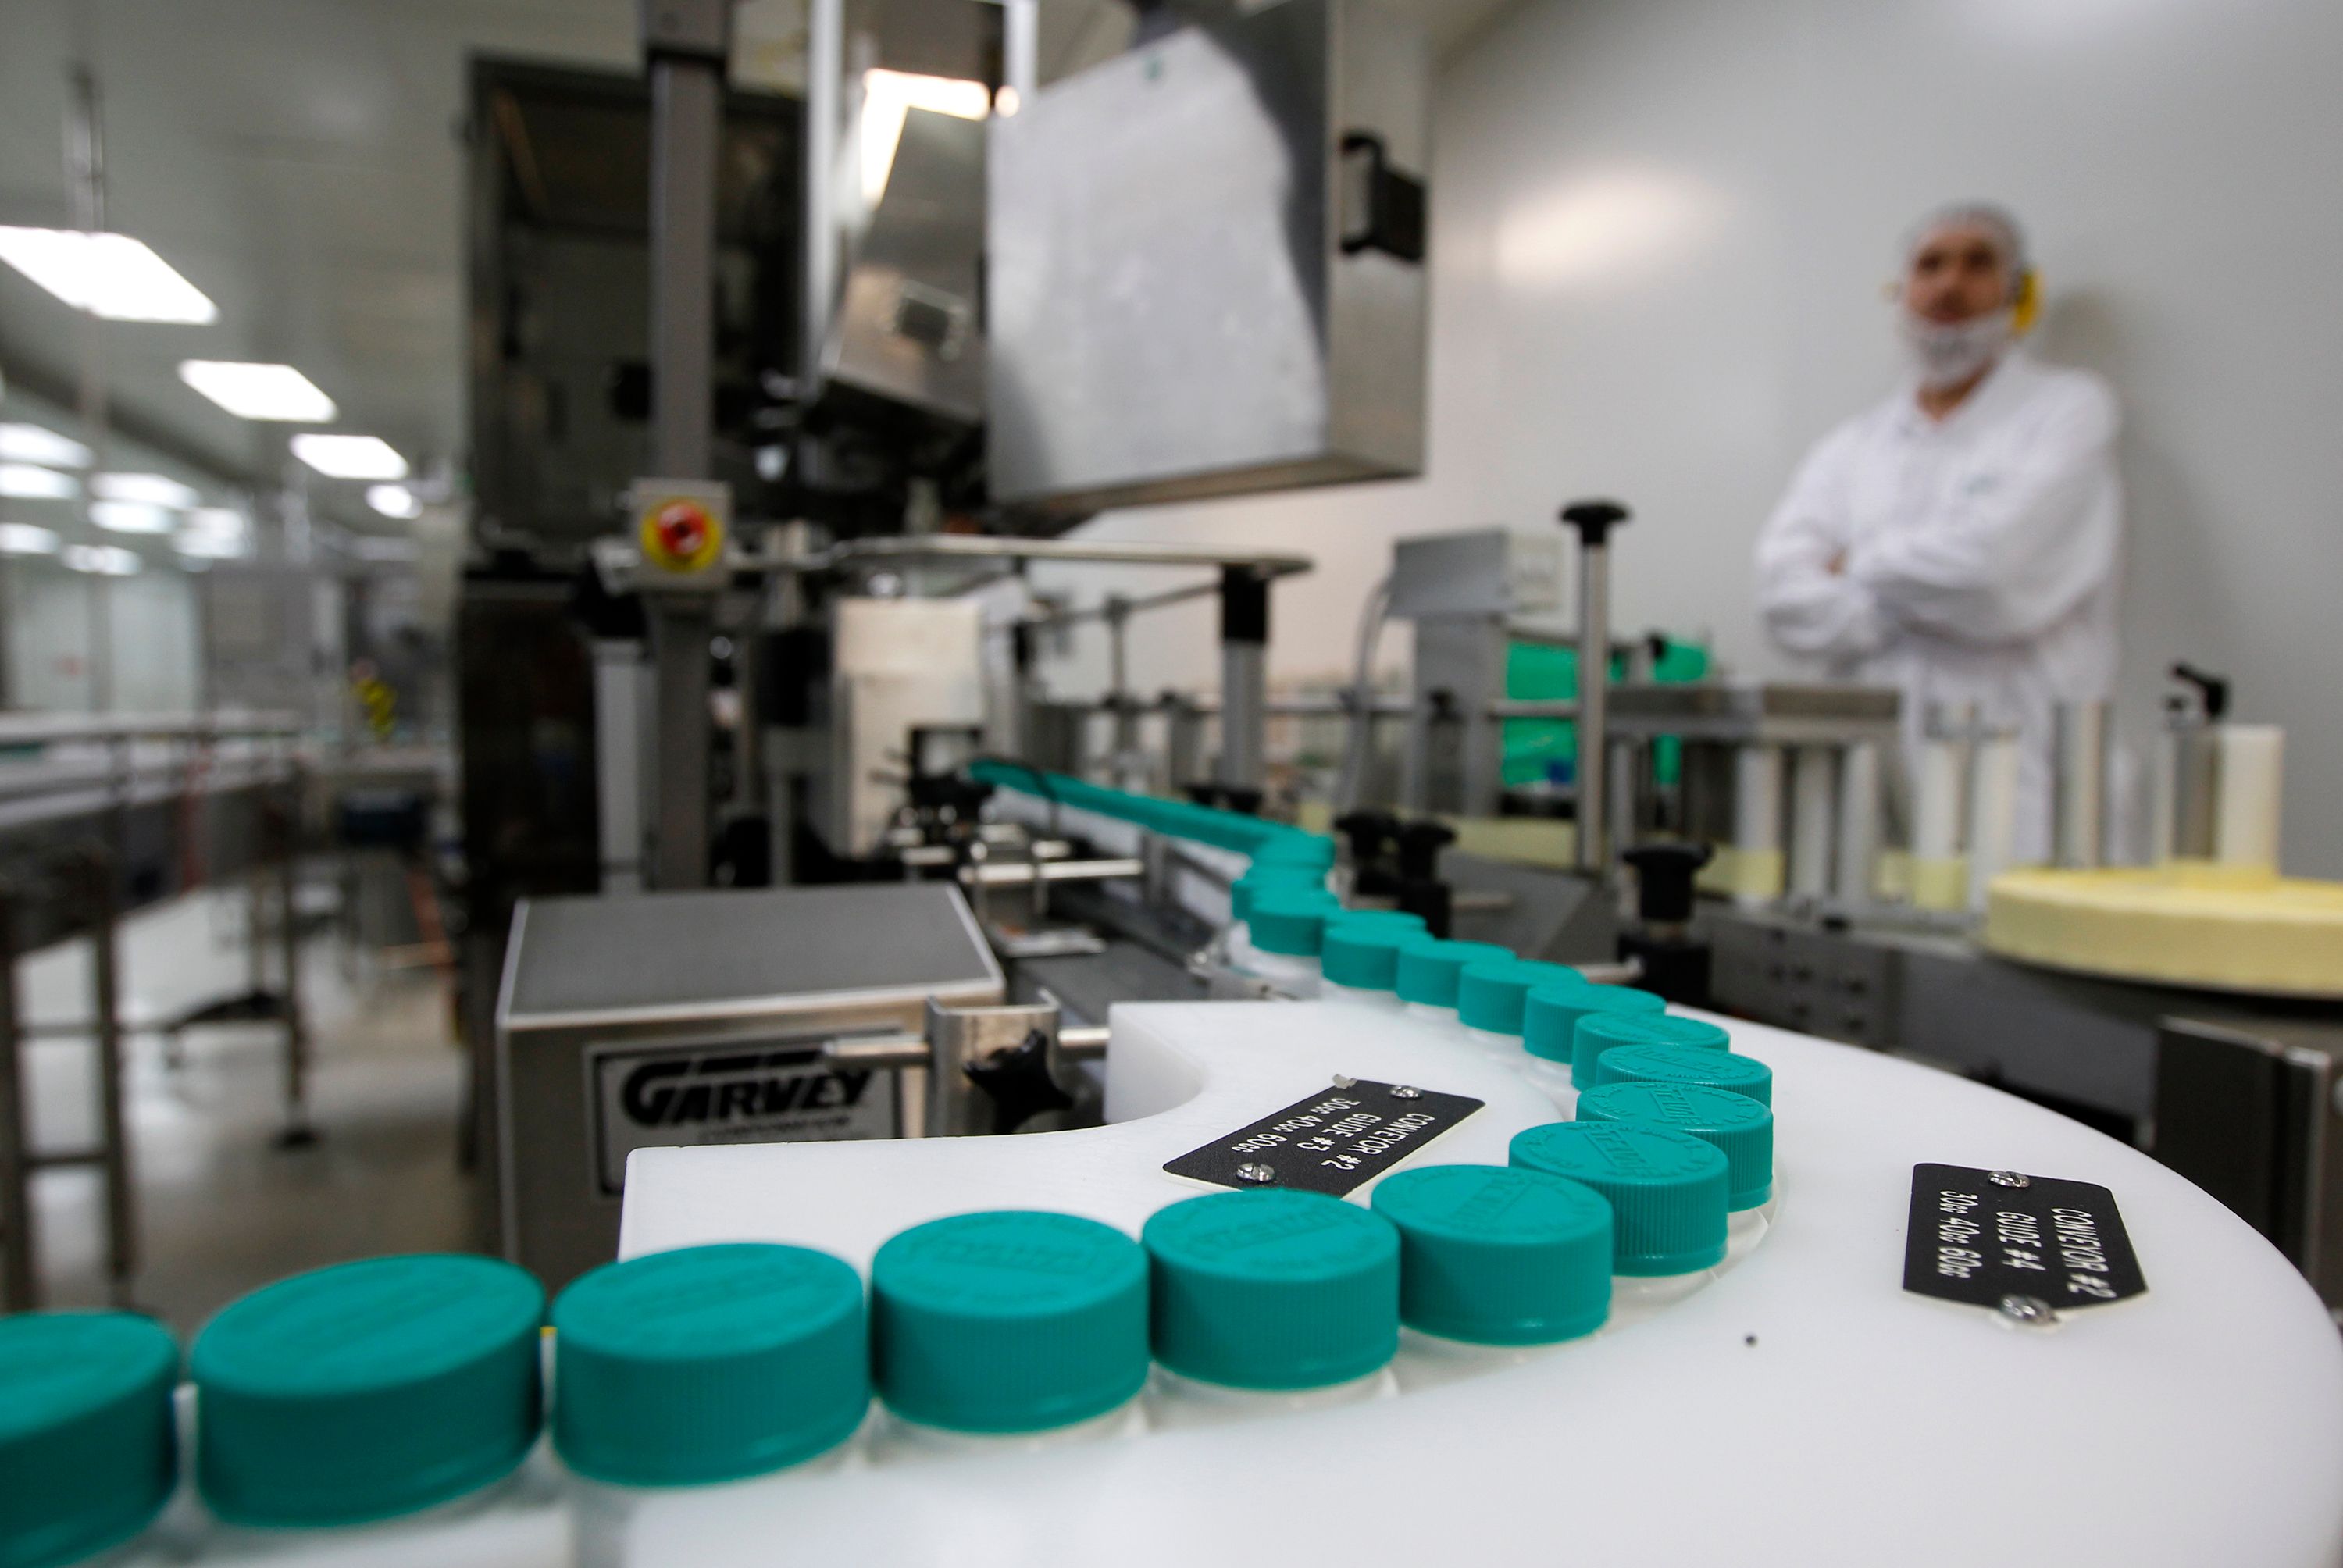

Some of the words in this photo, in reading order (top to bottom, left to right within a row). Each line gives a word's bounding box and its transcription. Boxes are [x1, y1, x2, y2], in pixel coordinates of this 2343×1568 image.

[622, 1049, 875, 1127] GARVEY
[1309, 1097, 1361, 1115] 30cc
[1271, 1114, 1324, 1133] 40cc
[1321, 1113, 1382, 1138] GUIDE
[1346, 1113, 1435, 1155] CONVEYOR
[1231, 1133, 1288, 1153] 60cc
[1296, 1136, 1336, 1152] #3
[1321, 1154, 1362, 1171] #2
[1939, 1190, 1979, 1214] 30cc
[1938, 1217, 1981, 1244] 40cc
[1995, 1211, 2042, 1248] GUIDE
[2051, 1208, 2109, 1272] CONVEYOR
[1937, 1247, 1983, 1278] 60cc
[2002, 1249, 2046, 1270] #4
[2067, 1274, 2117, 1298] #2
